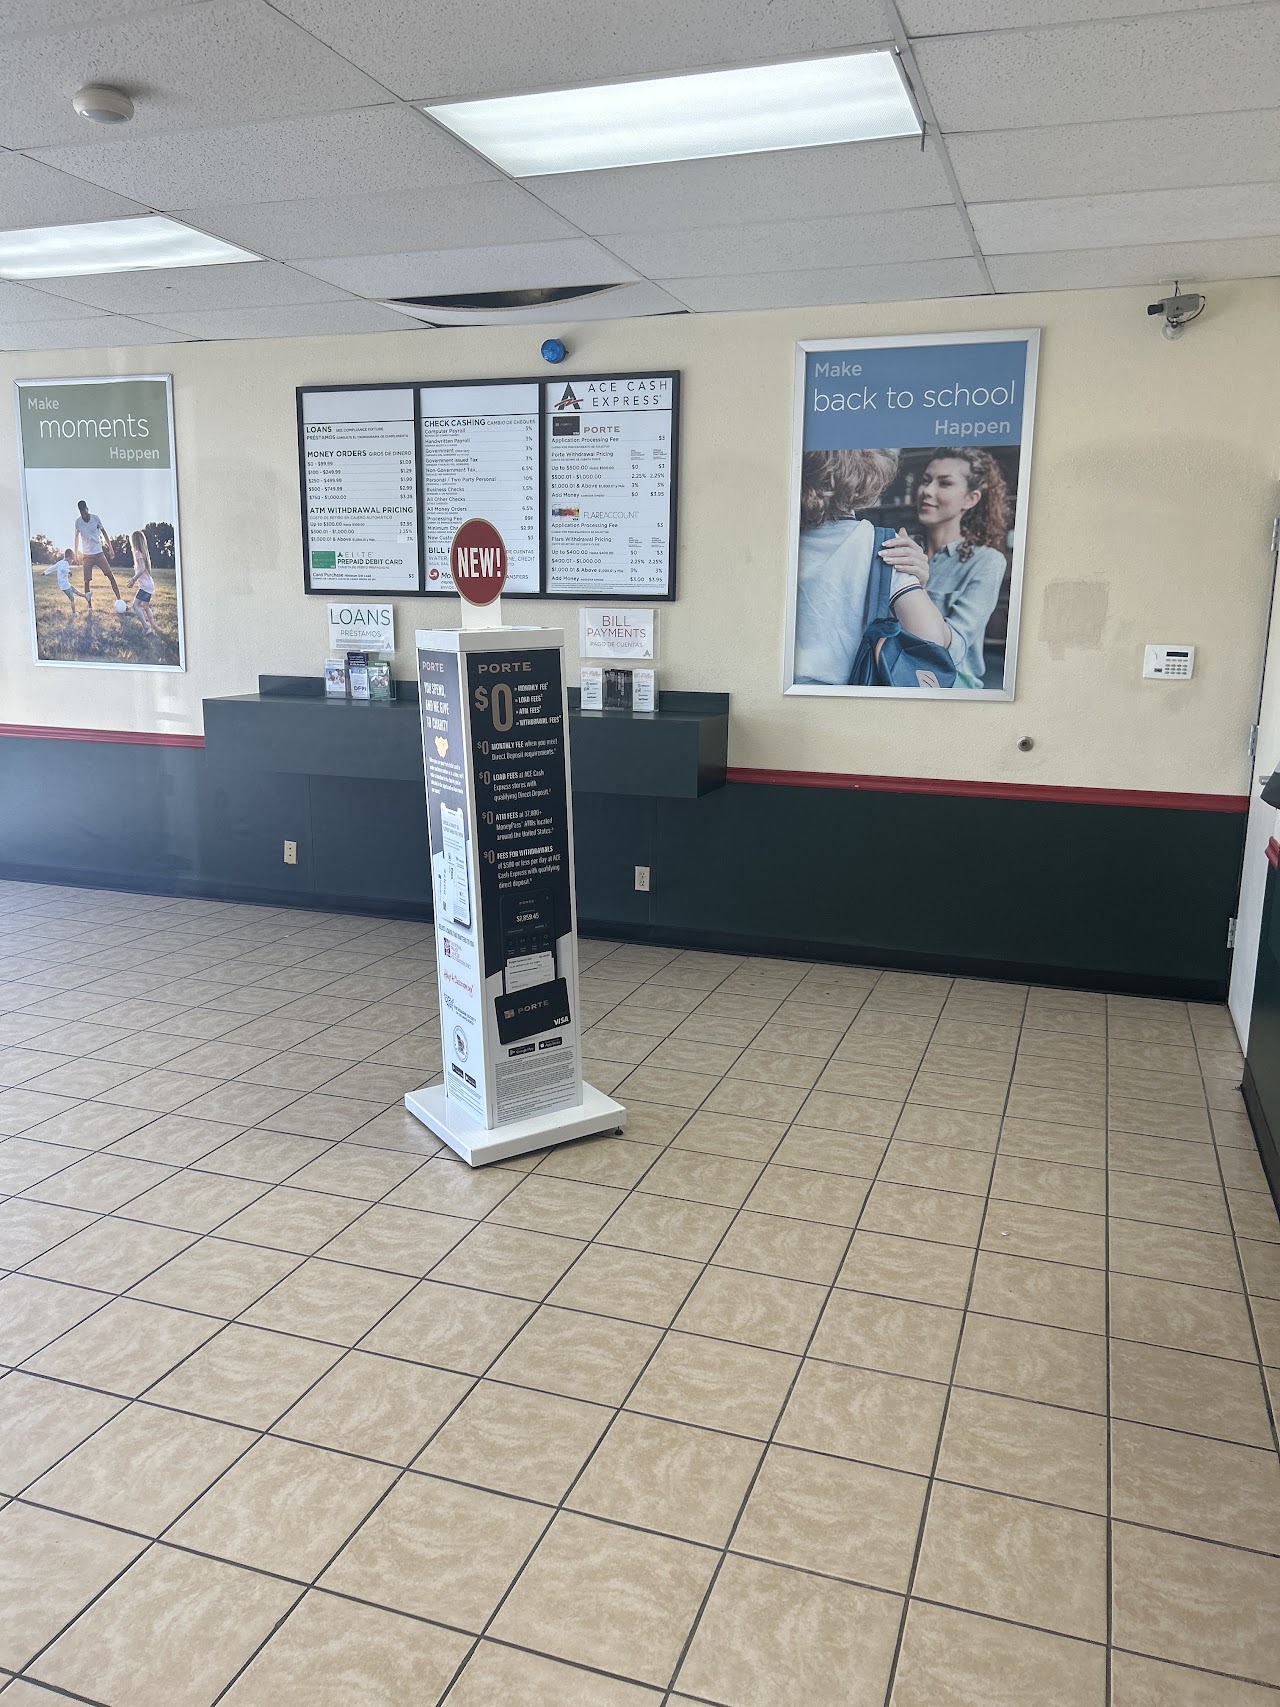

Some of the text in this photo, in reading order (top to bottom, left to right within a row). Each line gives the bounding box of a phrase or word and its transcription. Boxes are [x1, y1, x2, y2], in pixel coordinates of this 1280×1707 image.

[815, 362, 862, 377] Make
[588, 381, 667, 392] ACE CASH
[814, 380, 1015, 411] back to school
[28, 397, 59, 410] Make
[40, 414, 149, 438] moments
[935, 420, 1010, 437] Happen
[110, 447, 159, 461] Happen
[458, 548, 501, 578] NEW!
[330, 609, 390, 625] LOANS
[602, 616, 631, 626] BILL
[341, 629, 381, 637] PRÉSTAMOS
[587, 629, 646, 638] PAYMENTS
[422, 661, 444, 672] PORTE
[478, 662, 532, 673] PORTE
[518, 684, 538, 692] MONTHLY
[475, 683, 513, 732] $0
[519, 707, 529, 715] ATM
[520, 717, 548, 726] WITHDRAWAL
[492, 742, 514, 750] MONTHLY
[507, 752, 523, 760] Deposit
[493, 773, 506, 781] LOAD
[494, 783, 511, 792] Express
[494, 791, 531, 802] qualifying Direct
[496, 812, 518, 821] ATM FEES
[537, 817, 552, 825] located
[497, 832, 513, 840] around
[522, 829, 536, 837] United
[497, 852, 508, 860] FEES
[520, 846, 553, 856] WITHDRAWALS
[510, 869, 527, 878] Express
[538, 865, 560, 874] qualifying
[499, 881, 512, 889] direct
[518, 1000, 549, 1014] PORTE
[553, 1016, 569, 1026] VISA
